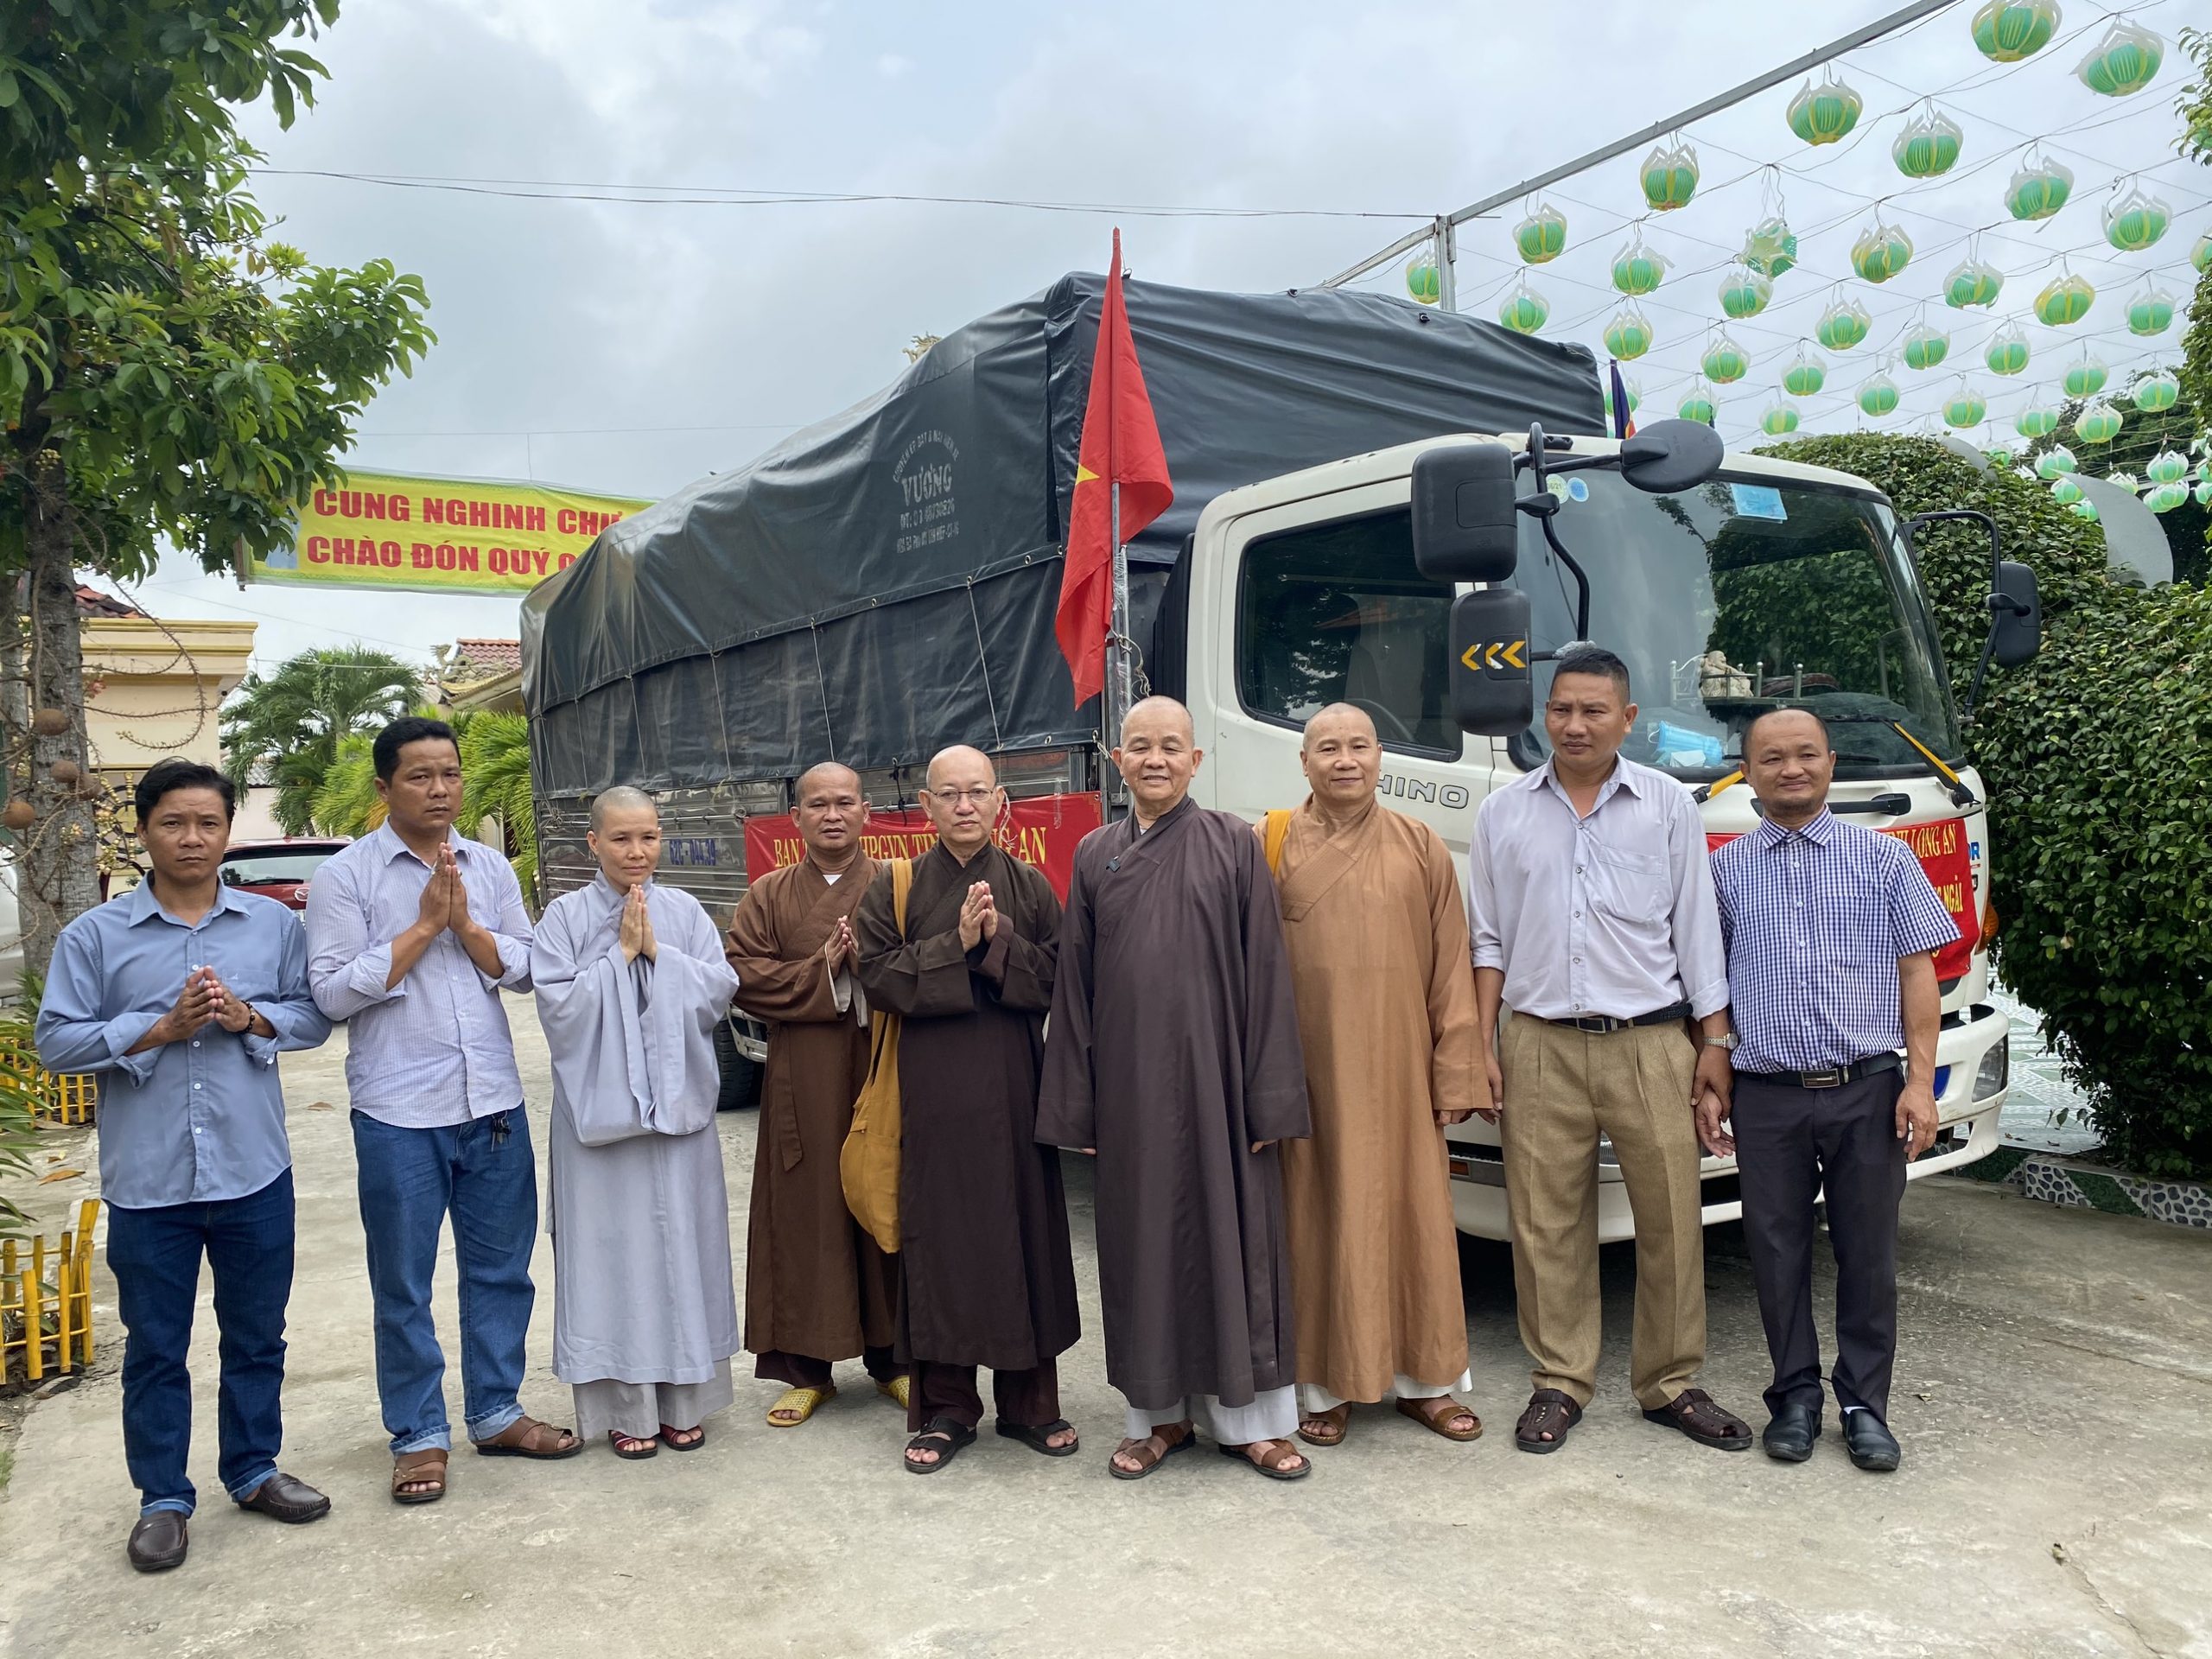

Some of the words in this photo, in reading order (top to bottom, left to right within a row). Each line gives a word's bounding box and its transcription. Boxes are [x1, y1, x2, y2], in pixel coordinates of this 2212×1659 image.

[314, 489, 410, 522] CUNG
[423, 497, 545, 531] NGHINH
[307, 535, 402, 567] CHÀO
[410, 540, 479, 571] ĐÓN
[488, 547, 550, 575] QUÝ
[773, 838, 799, 867] BAN
[1018, 826, 1047, 865] AN
[1911, 826, 1941, 858] LONG
[1943, 823, 1956, 855] AN
